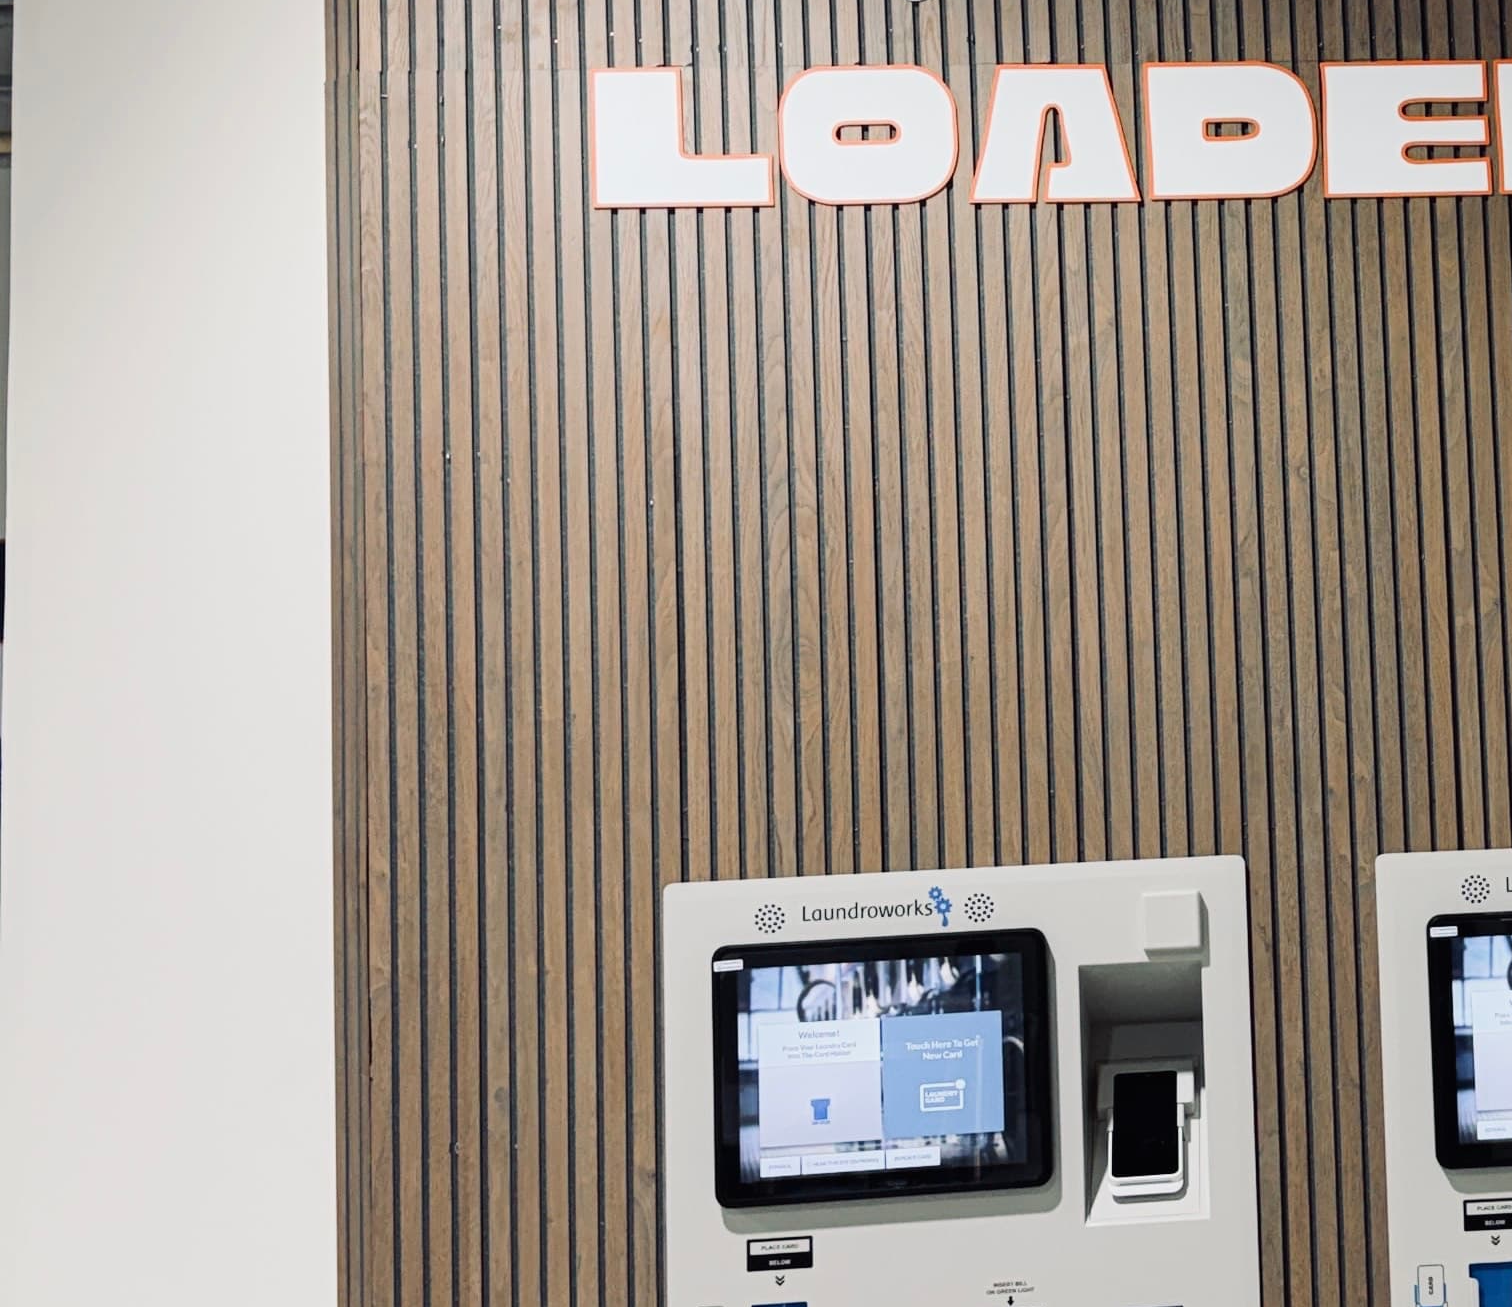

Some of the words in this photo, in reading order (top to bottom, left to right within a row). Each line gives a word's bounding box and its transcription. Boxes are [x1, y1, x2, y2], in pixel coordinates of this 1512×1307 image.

[802, 899, 933, 922] Laundroworks
[905, 1041, 930, 1051] Touch
[931, 1040, 951, 1050] Here
[952, 1040, 963, 1048] To
[963, 1038, 980, 1048] Get
[922, 1052, 942, 1061] New
[942, 1050, 963, 1059] Card
